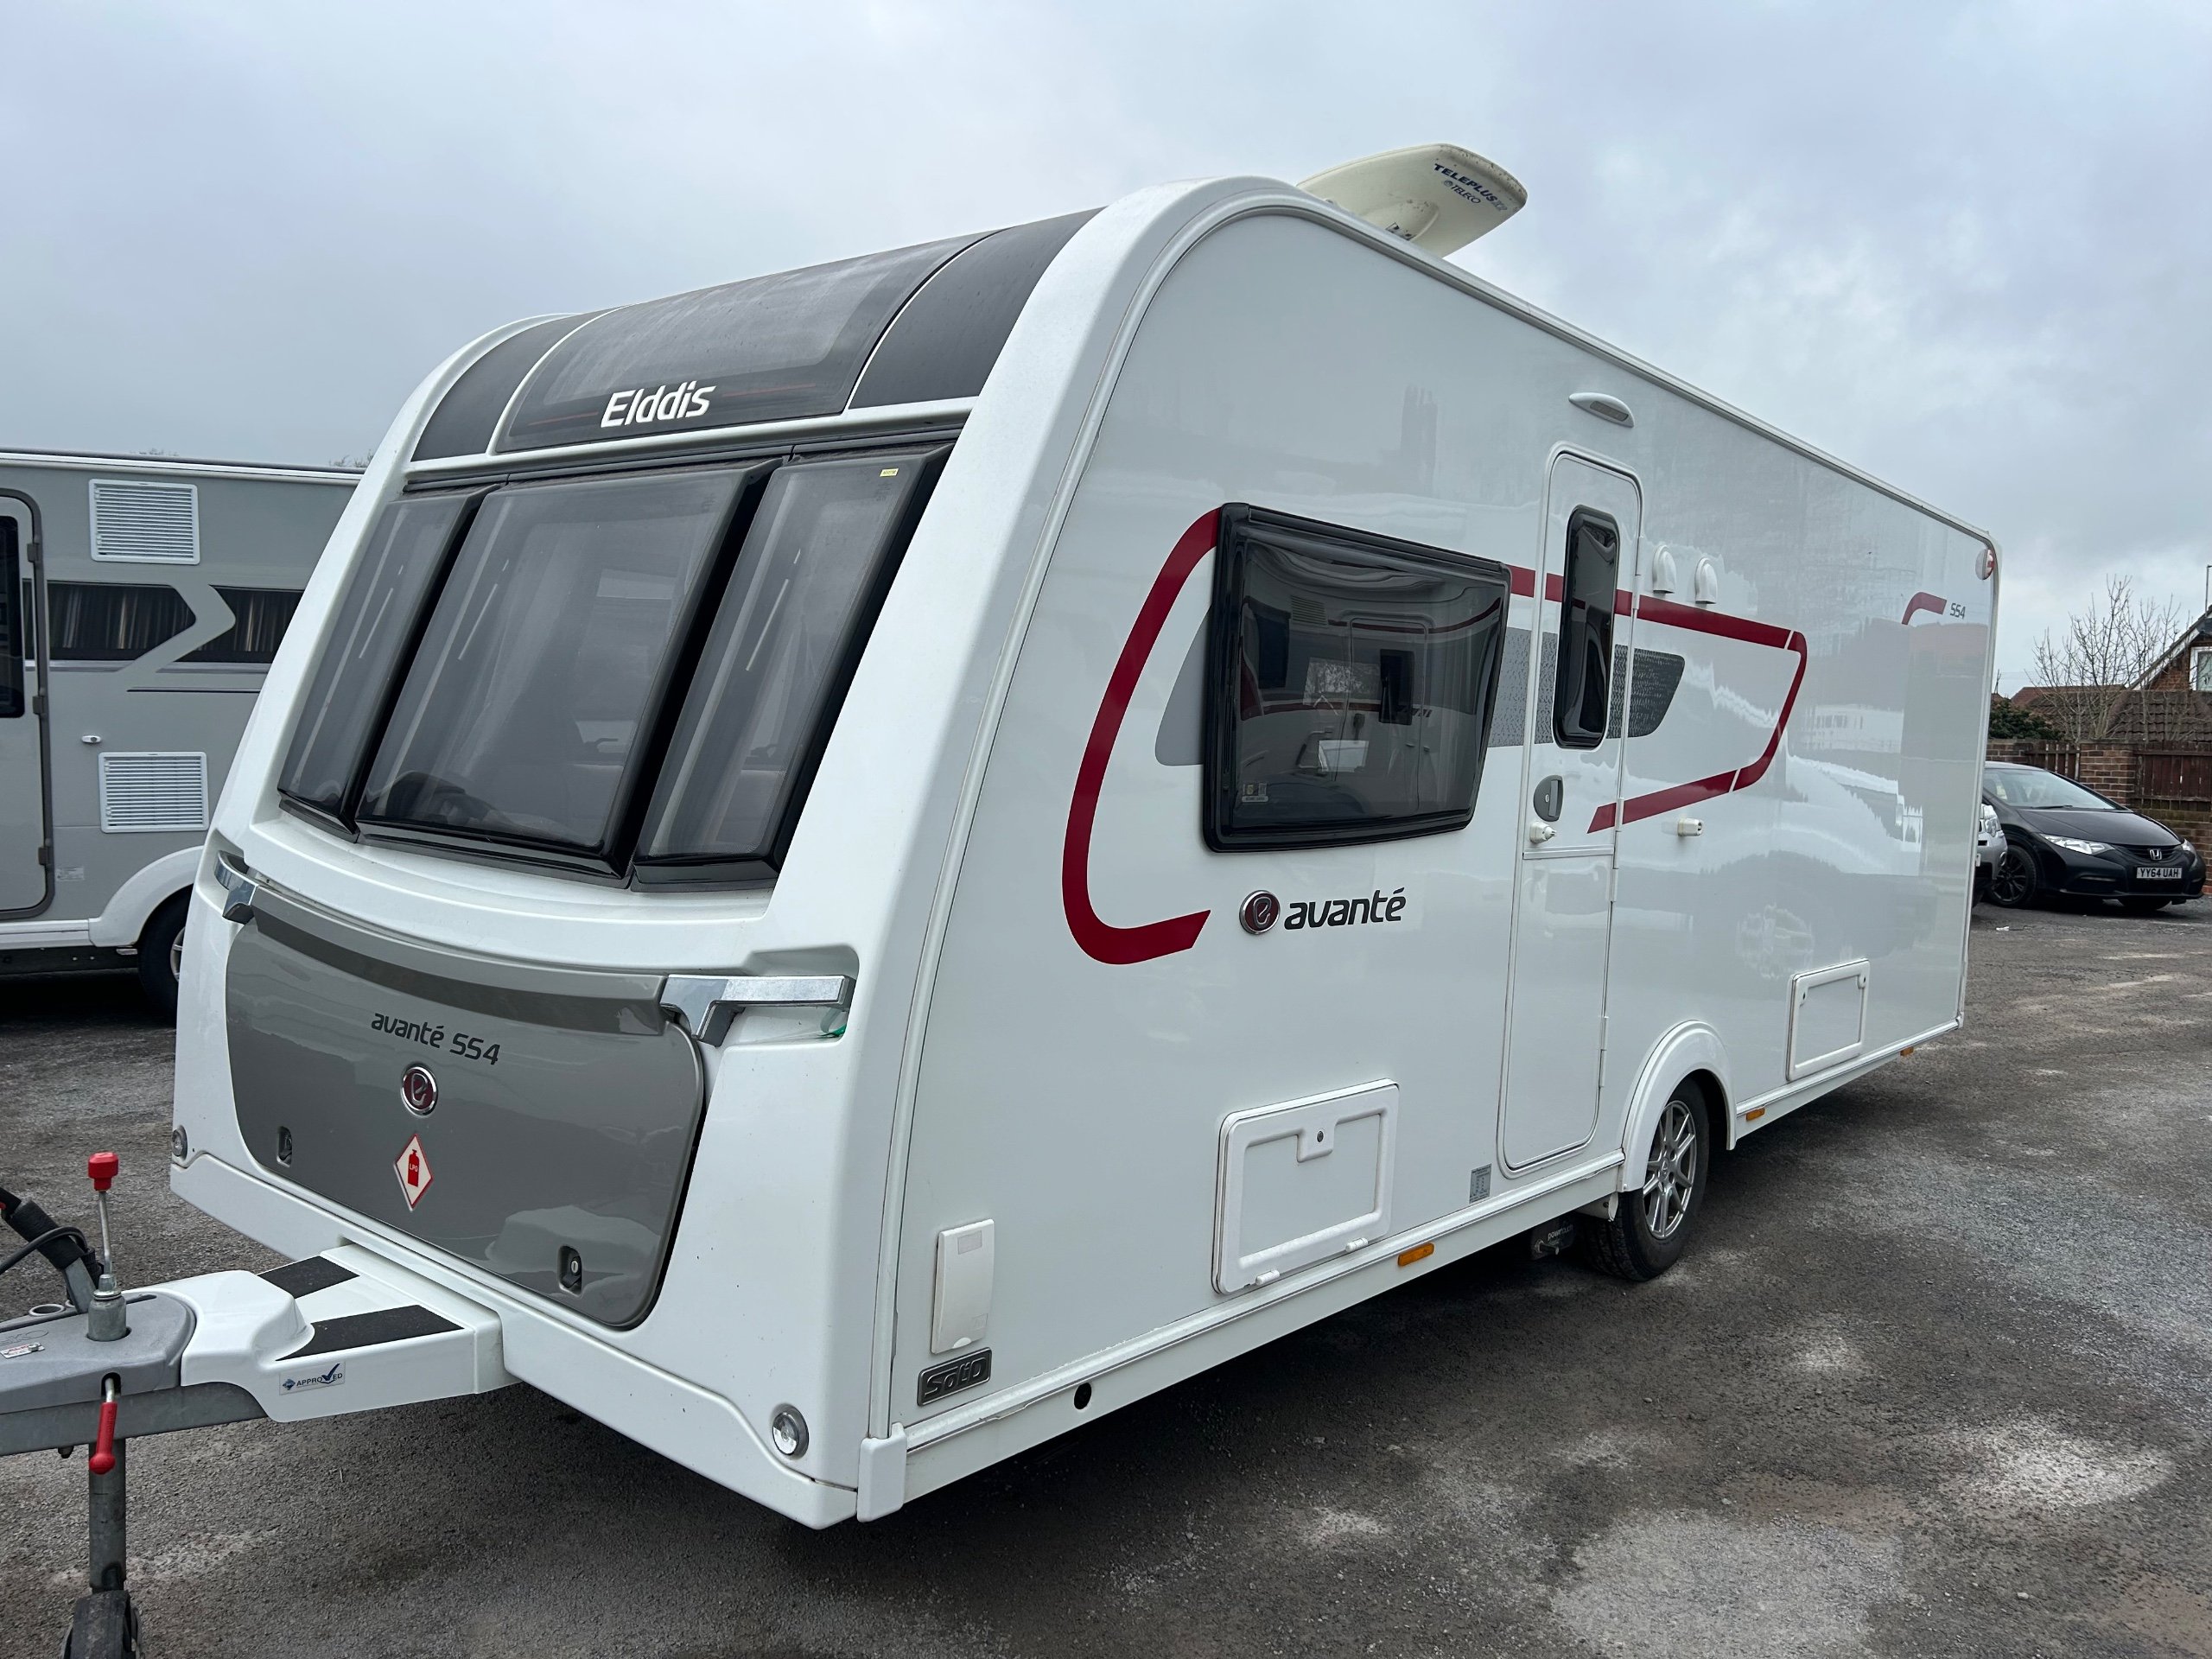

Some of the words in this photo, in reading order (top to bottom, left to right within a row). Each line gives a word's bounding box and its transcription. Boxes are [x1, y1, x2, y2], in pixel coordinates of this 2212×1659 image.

[1433, 163, 1498, 202] TELEPLUS
[1451, 185, 1481, 204] TELECO
[601, 380, 717, 428] Elddis
[1949, 602, 1966, 620] 554
[2140, 868, 2162, 878] YY64
[2163, 868, 2178, 878] UAH
[1284, 887, 1407, 930] avanté
[371, 1013, 445, 1048] avanté
[449, 1033, 500, 1065] 554
[409, 1163, 418, 1173] LPG
